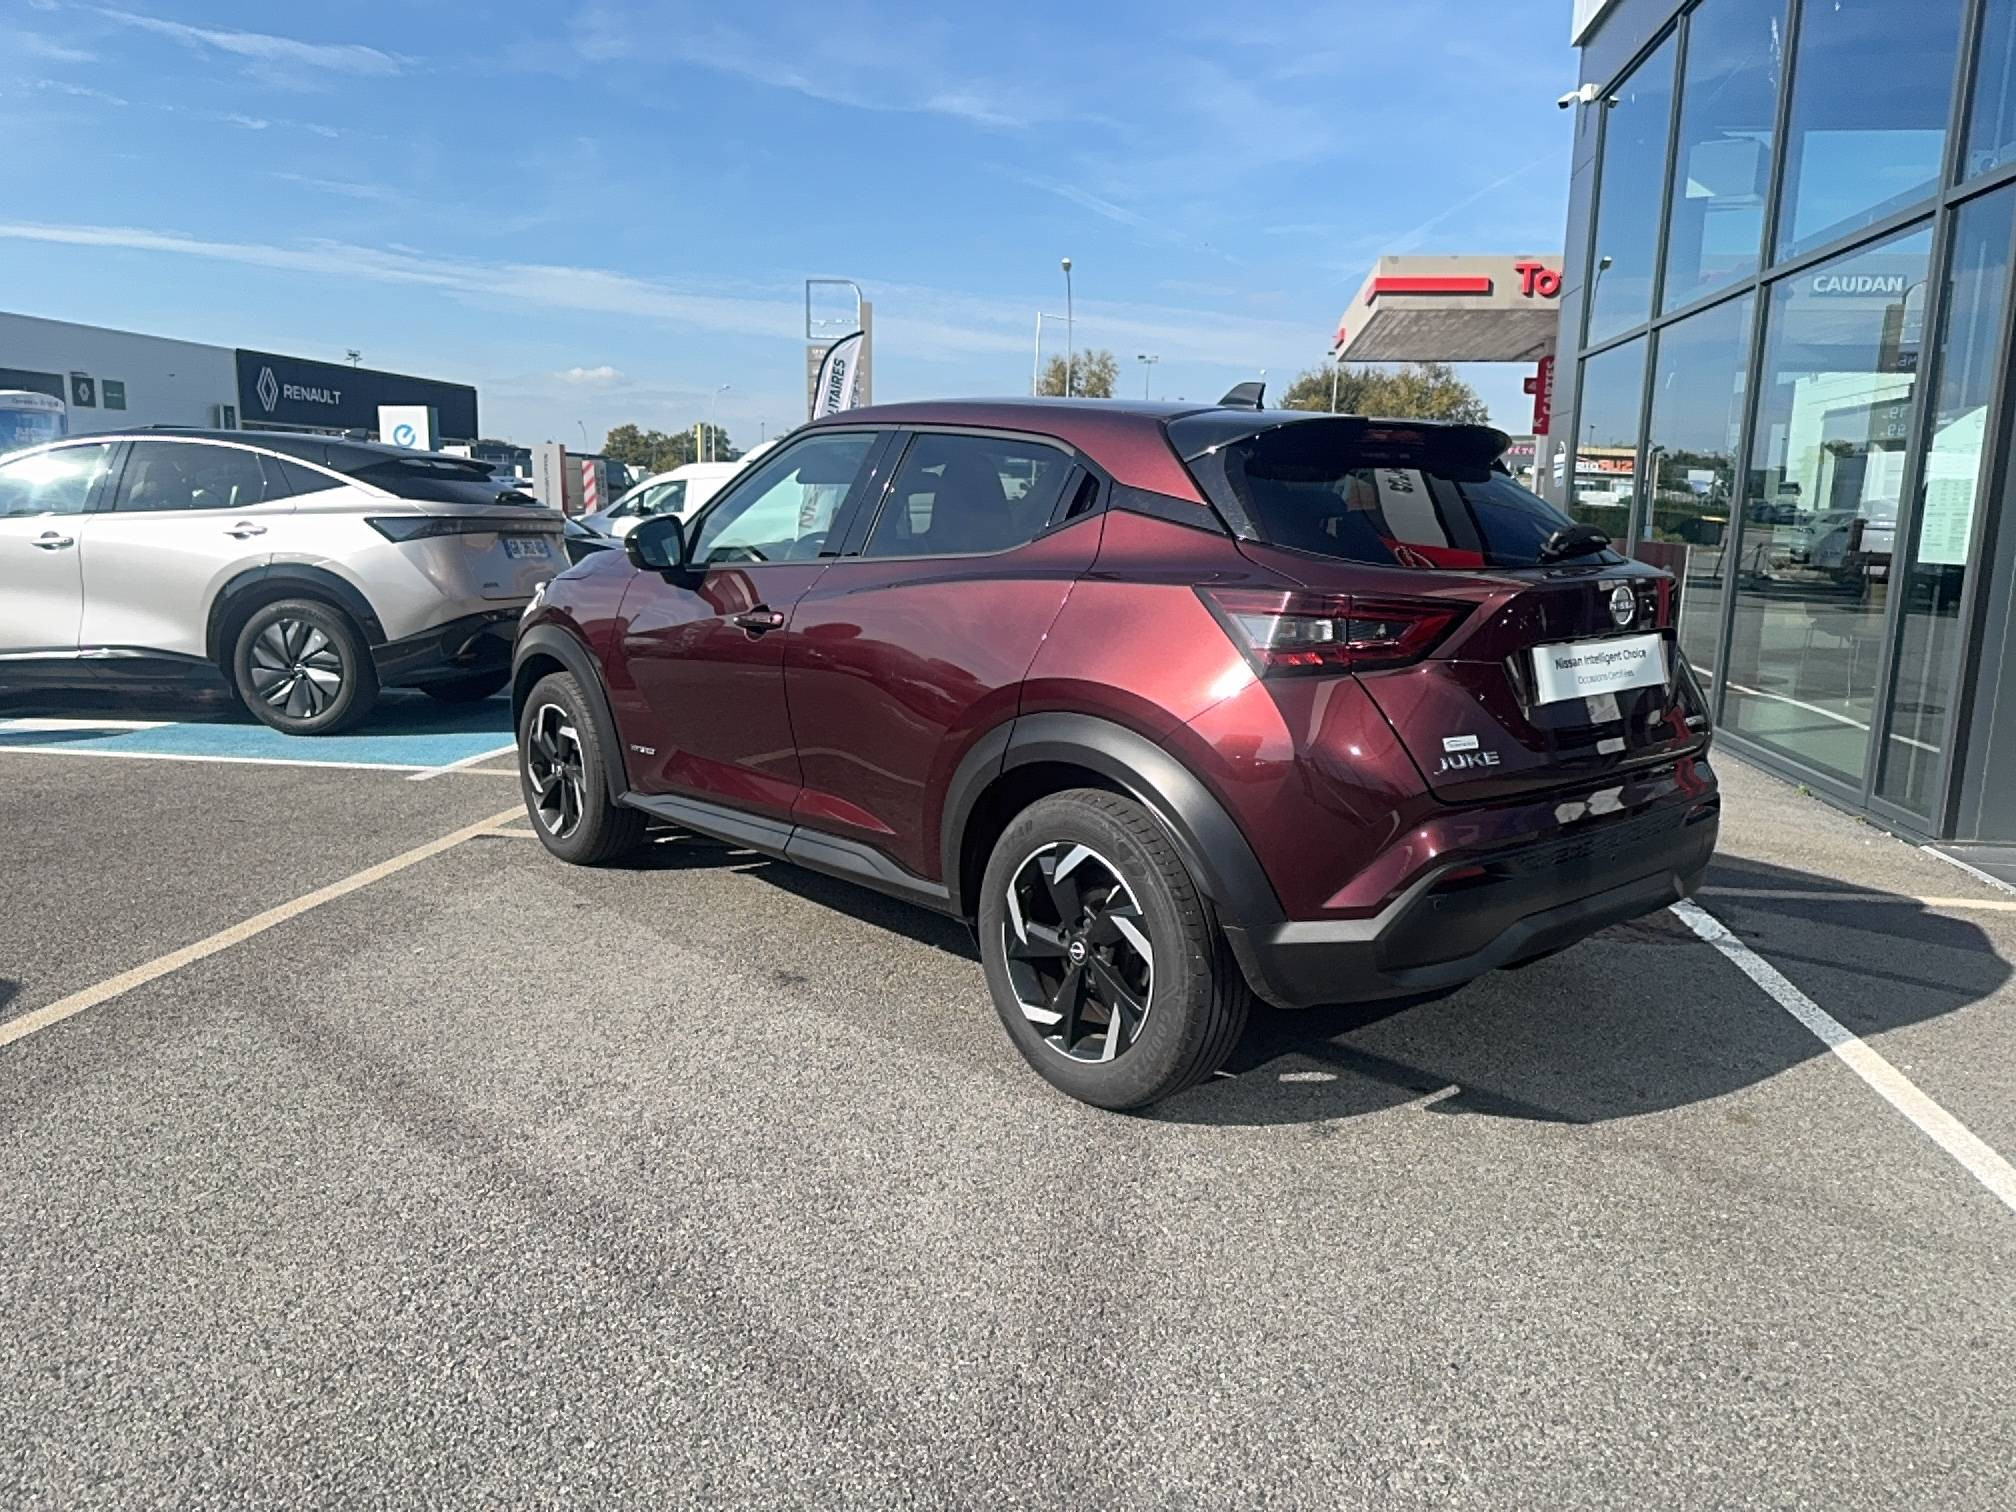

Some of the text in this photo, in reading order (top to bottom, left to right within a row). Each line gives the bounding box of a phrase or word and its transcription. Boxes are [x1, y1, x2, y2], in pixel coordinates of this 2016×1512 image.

[1813, 275, 1903, 292] CAUDAN
[283, 383, 341, 405] RENAULT
[1555, 648, 1647, 670] Nissan Intelligent Choice
[1433, 751, 1500, 775] JUKE
